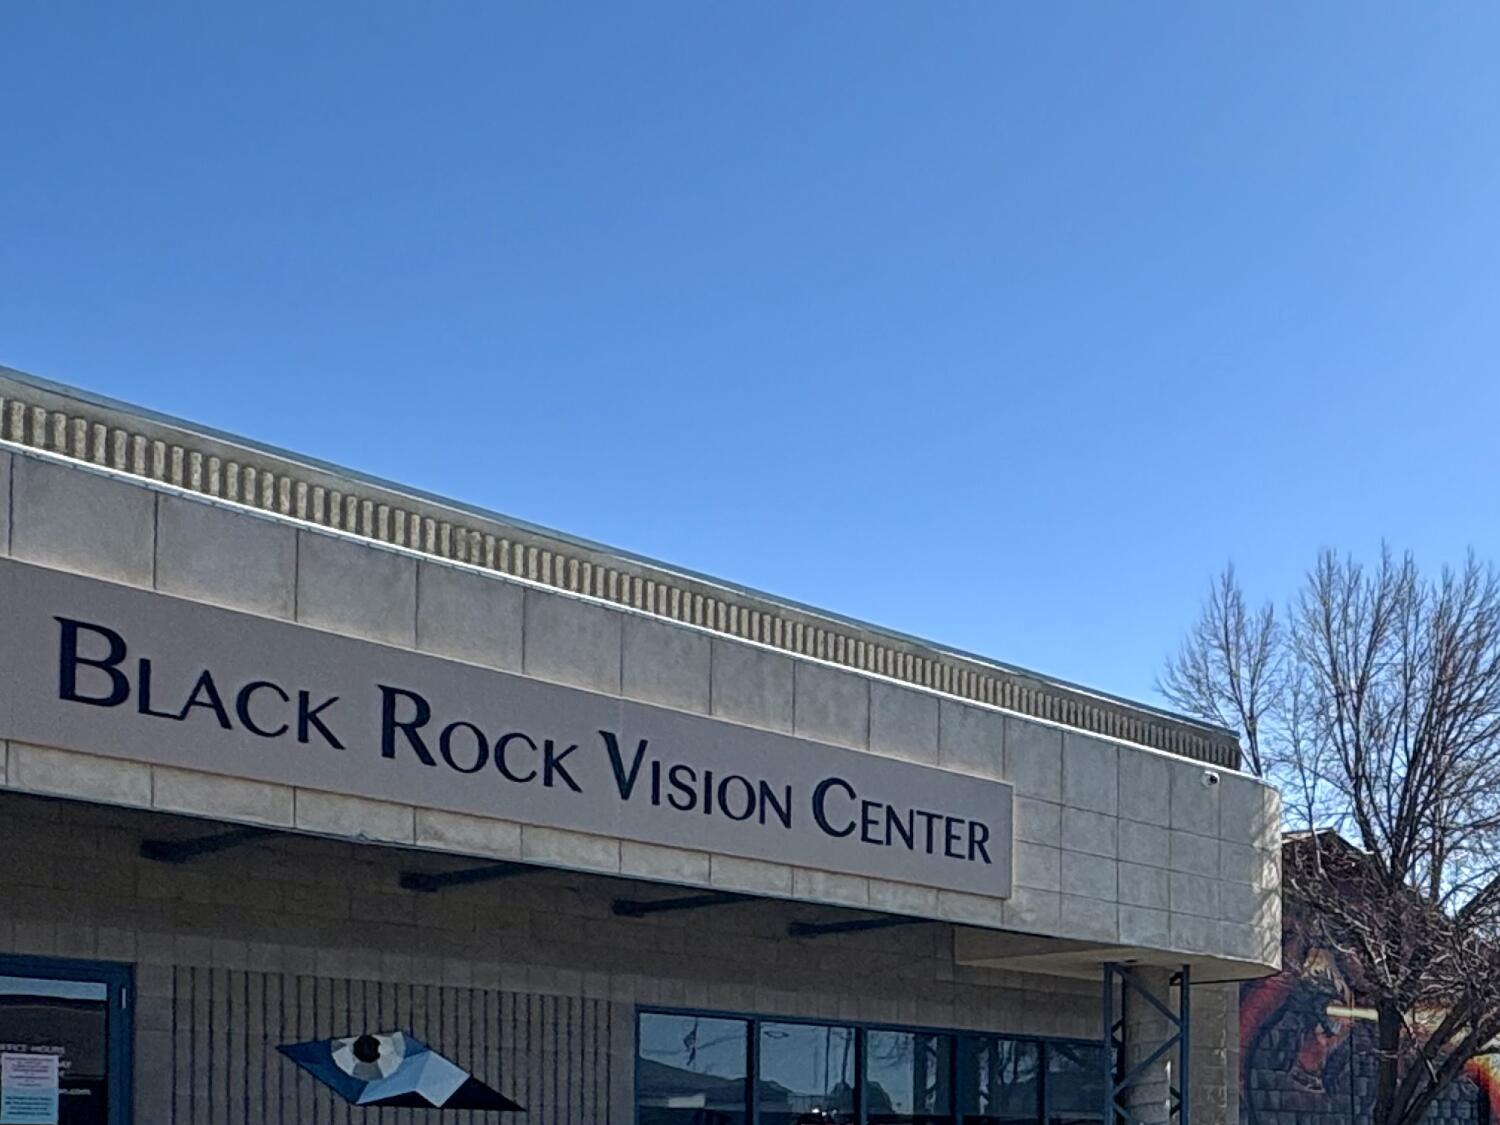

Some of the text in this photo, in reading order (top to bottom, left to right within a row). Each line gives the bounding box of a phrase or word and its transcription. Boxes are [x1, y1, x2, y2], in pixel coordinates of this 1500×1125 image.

[52, 615, 992, 865] BLACK ROCK VISION CENTER
